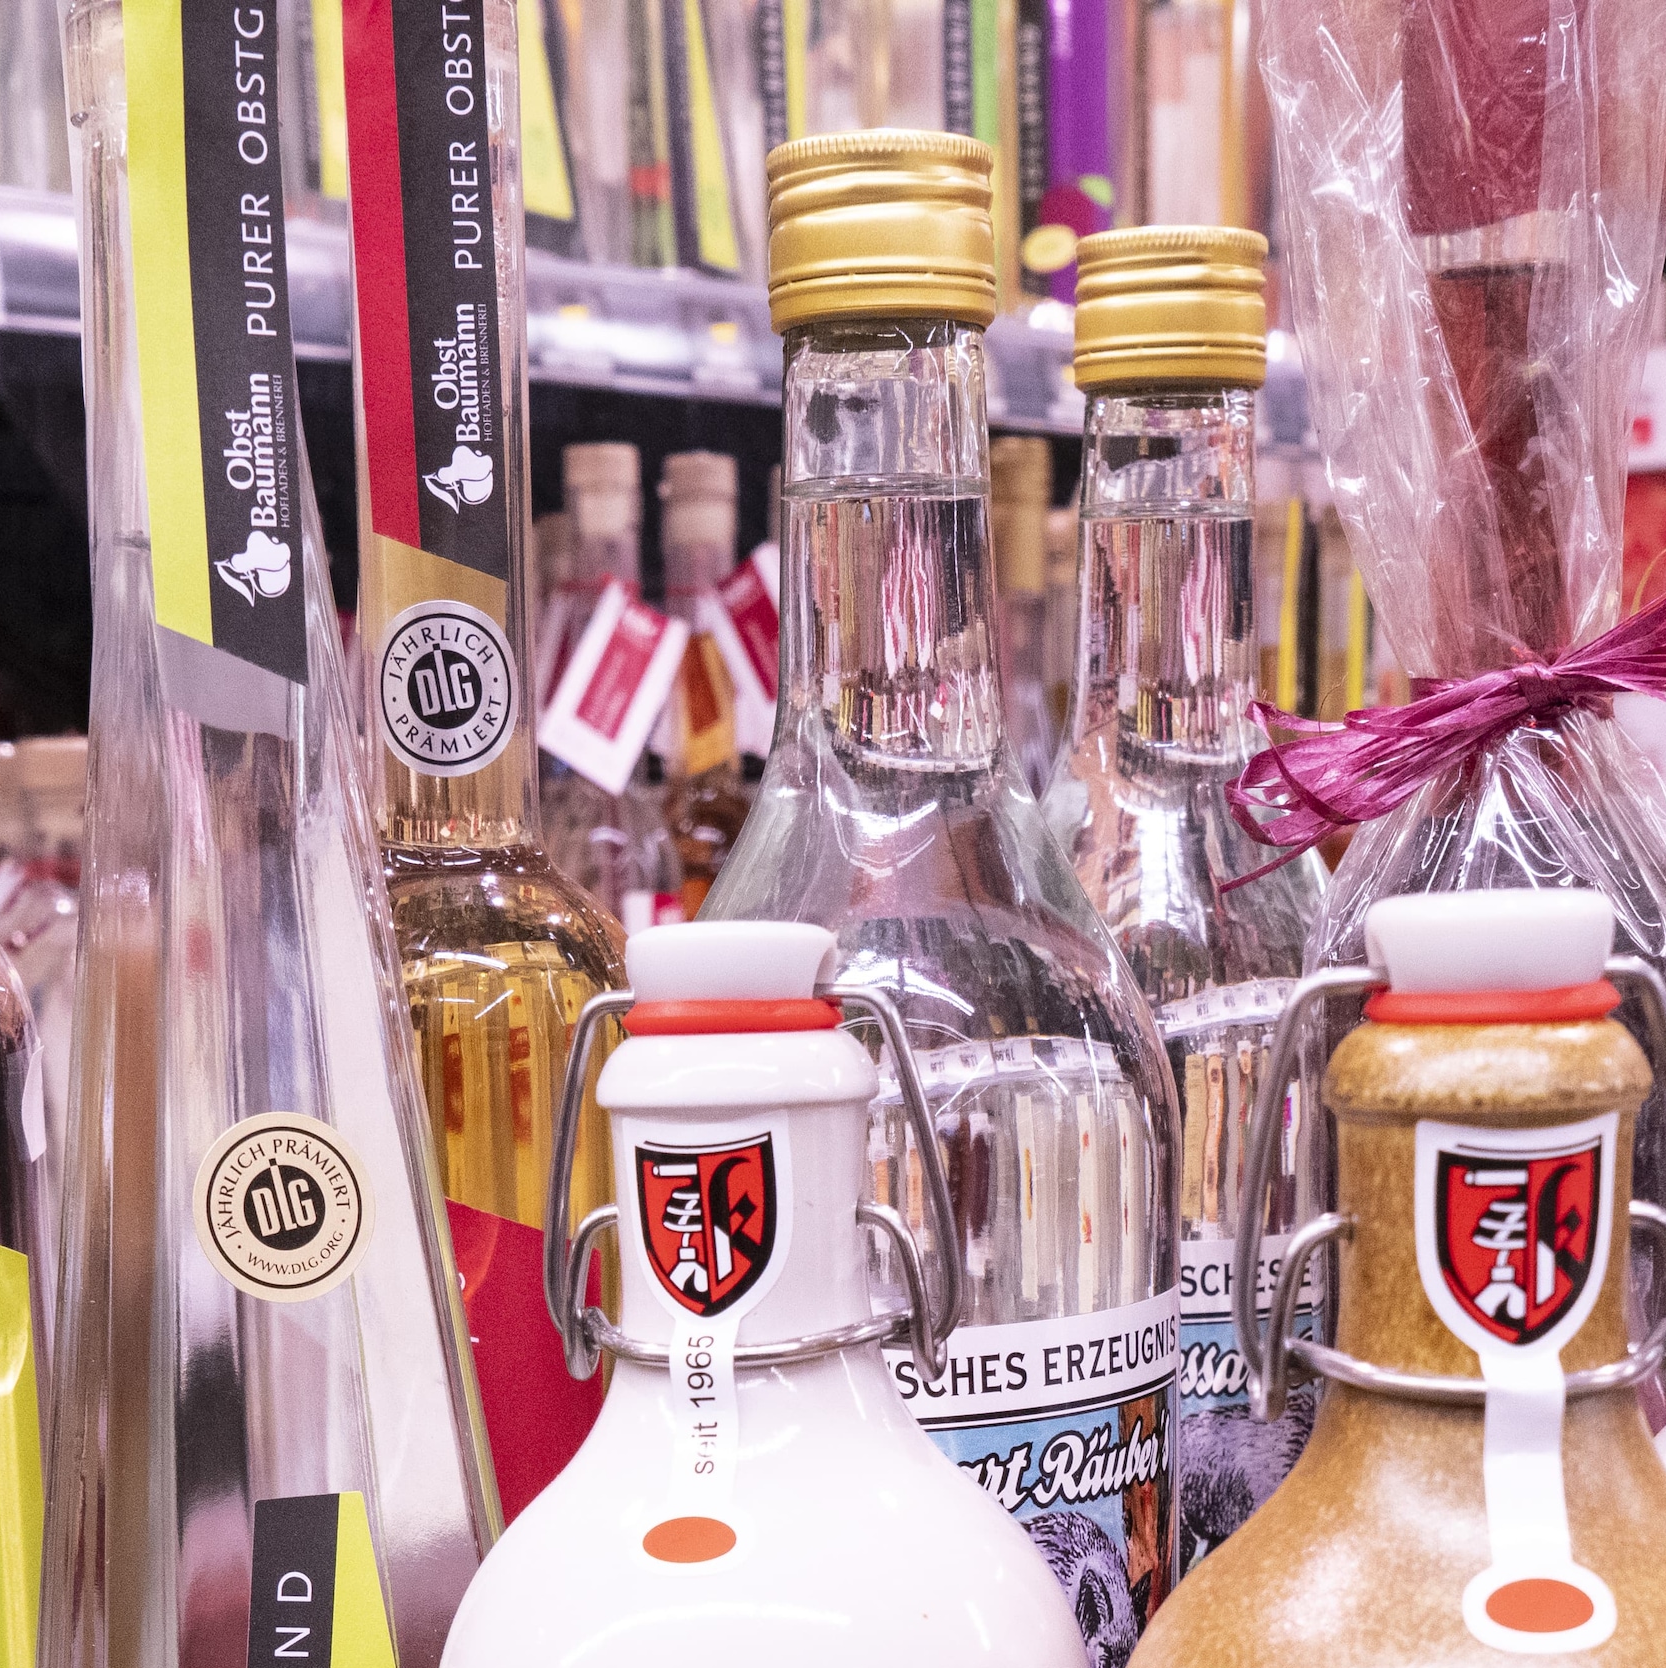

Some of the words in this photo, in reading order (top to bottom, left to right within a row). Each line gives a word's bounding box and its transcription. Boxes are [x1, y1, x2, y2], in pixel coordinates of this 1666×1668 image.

[233, 7, 269, 165] OBSTG
[441, 0, 475, 116] OBST
[449, 141, 483, 269] PURER
[241, 193, 277, 336] PURER
[476, 302, 491, 366] BRENNEREI
[271, 373, 287, 442] BRENNEREI
[431, 336, 460, 410] Obst
[455, 302, 482, 443] Baumann
[480, 367, 491, 376] &
[481, 378, 494, 443] HOFLADEN
[223, 408, 255, 491] Obst
[248, 372, 278, 527] Baumann
[276, 446, 289, 455] &
[276, 464, 291, 529] HOFLADEN
[388, 624, 494, 683] JÄHRLICH
[413, 643, 476, 717] DLG
[395, 694, 502, 754] PRÄMIERT
[217, 1143, 266, 1239] JÄHRLICH
[272, 1138, 351, 1211] PRÄMIERT
[250, 1157, 318, 1238] DLG
[247, 1231, 344, 1276] WWW.DLG.ORG
[685, 1335, 717, 1409] 1965
[1043, 1315, 1177, 1387] ERZEUGNIS
